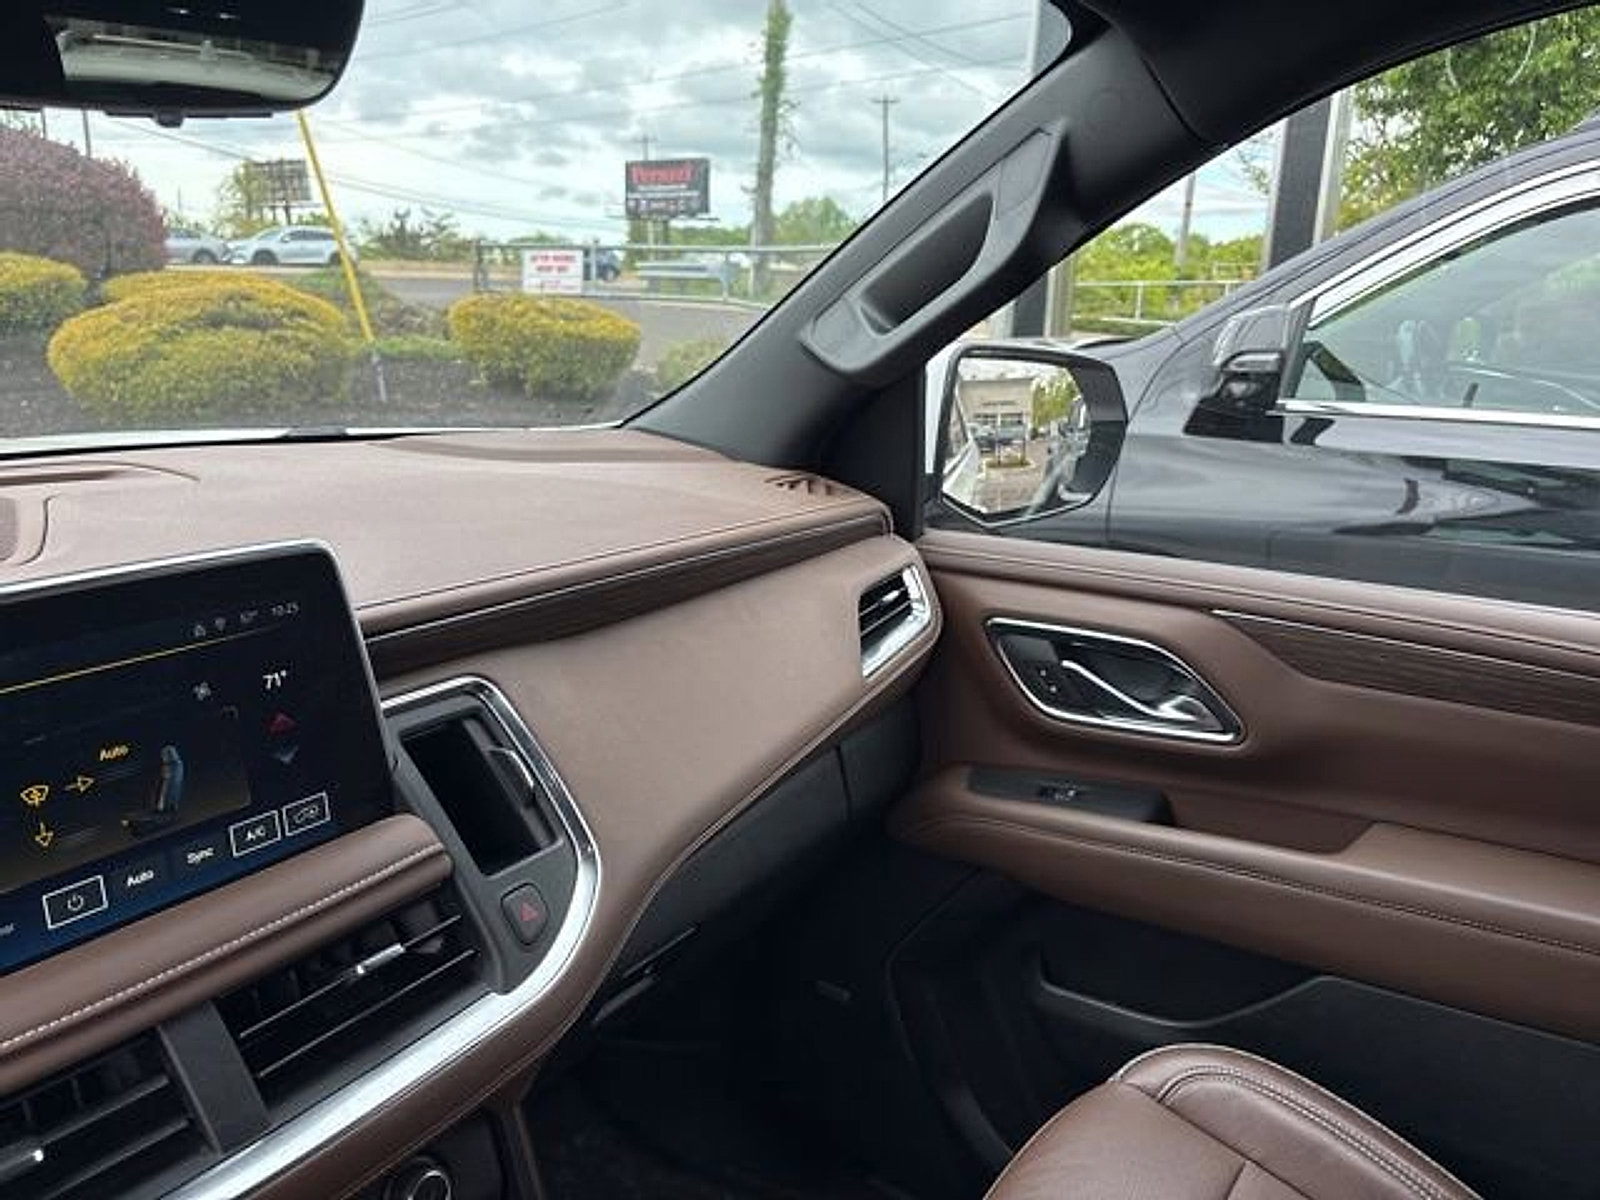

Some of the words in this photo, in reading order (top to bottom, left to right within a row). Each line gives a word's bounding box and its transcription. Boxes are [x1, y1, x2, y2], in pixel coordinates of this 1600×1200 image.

[99, 744, 129, 761] Auto
[187, 847, 214, 864] Sync
[126, 868, 155, 886] Auto
